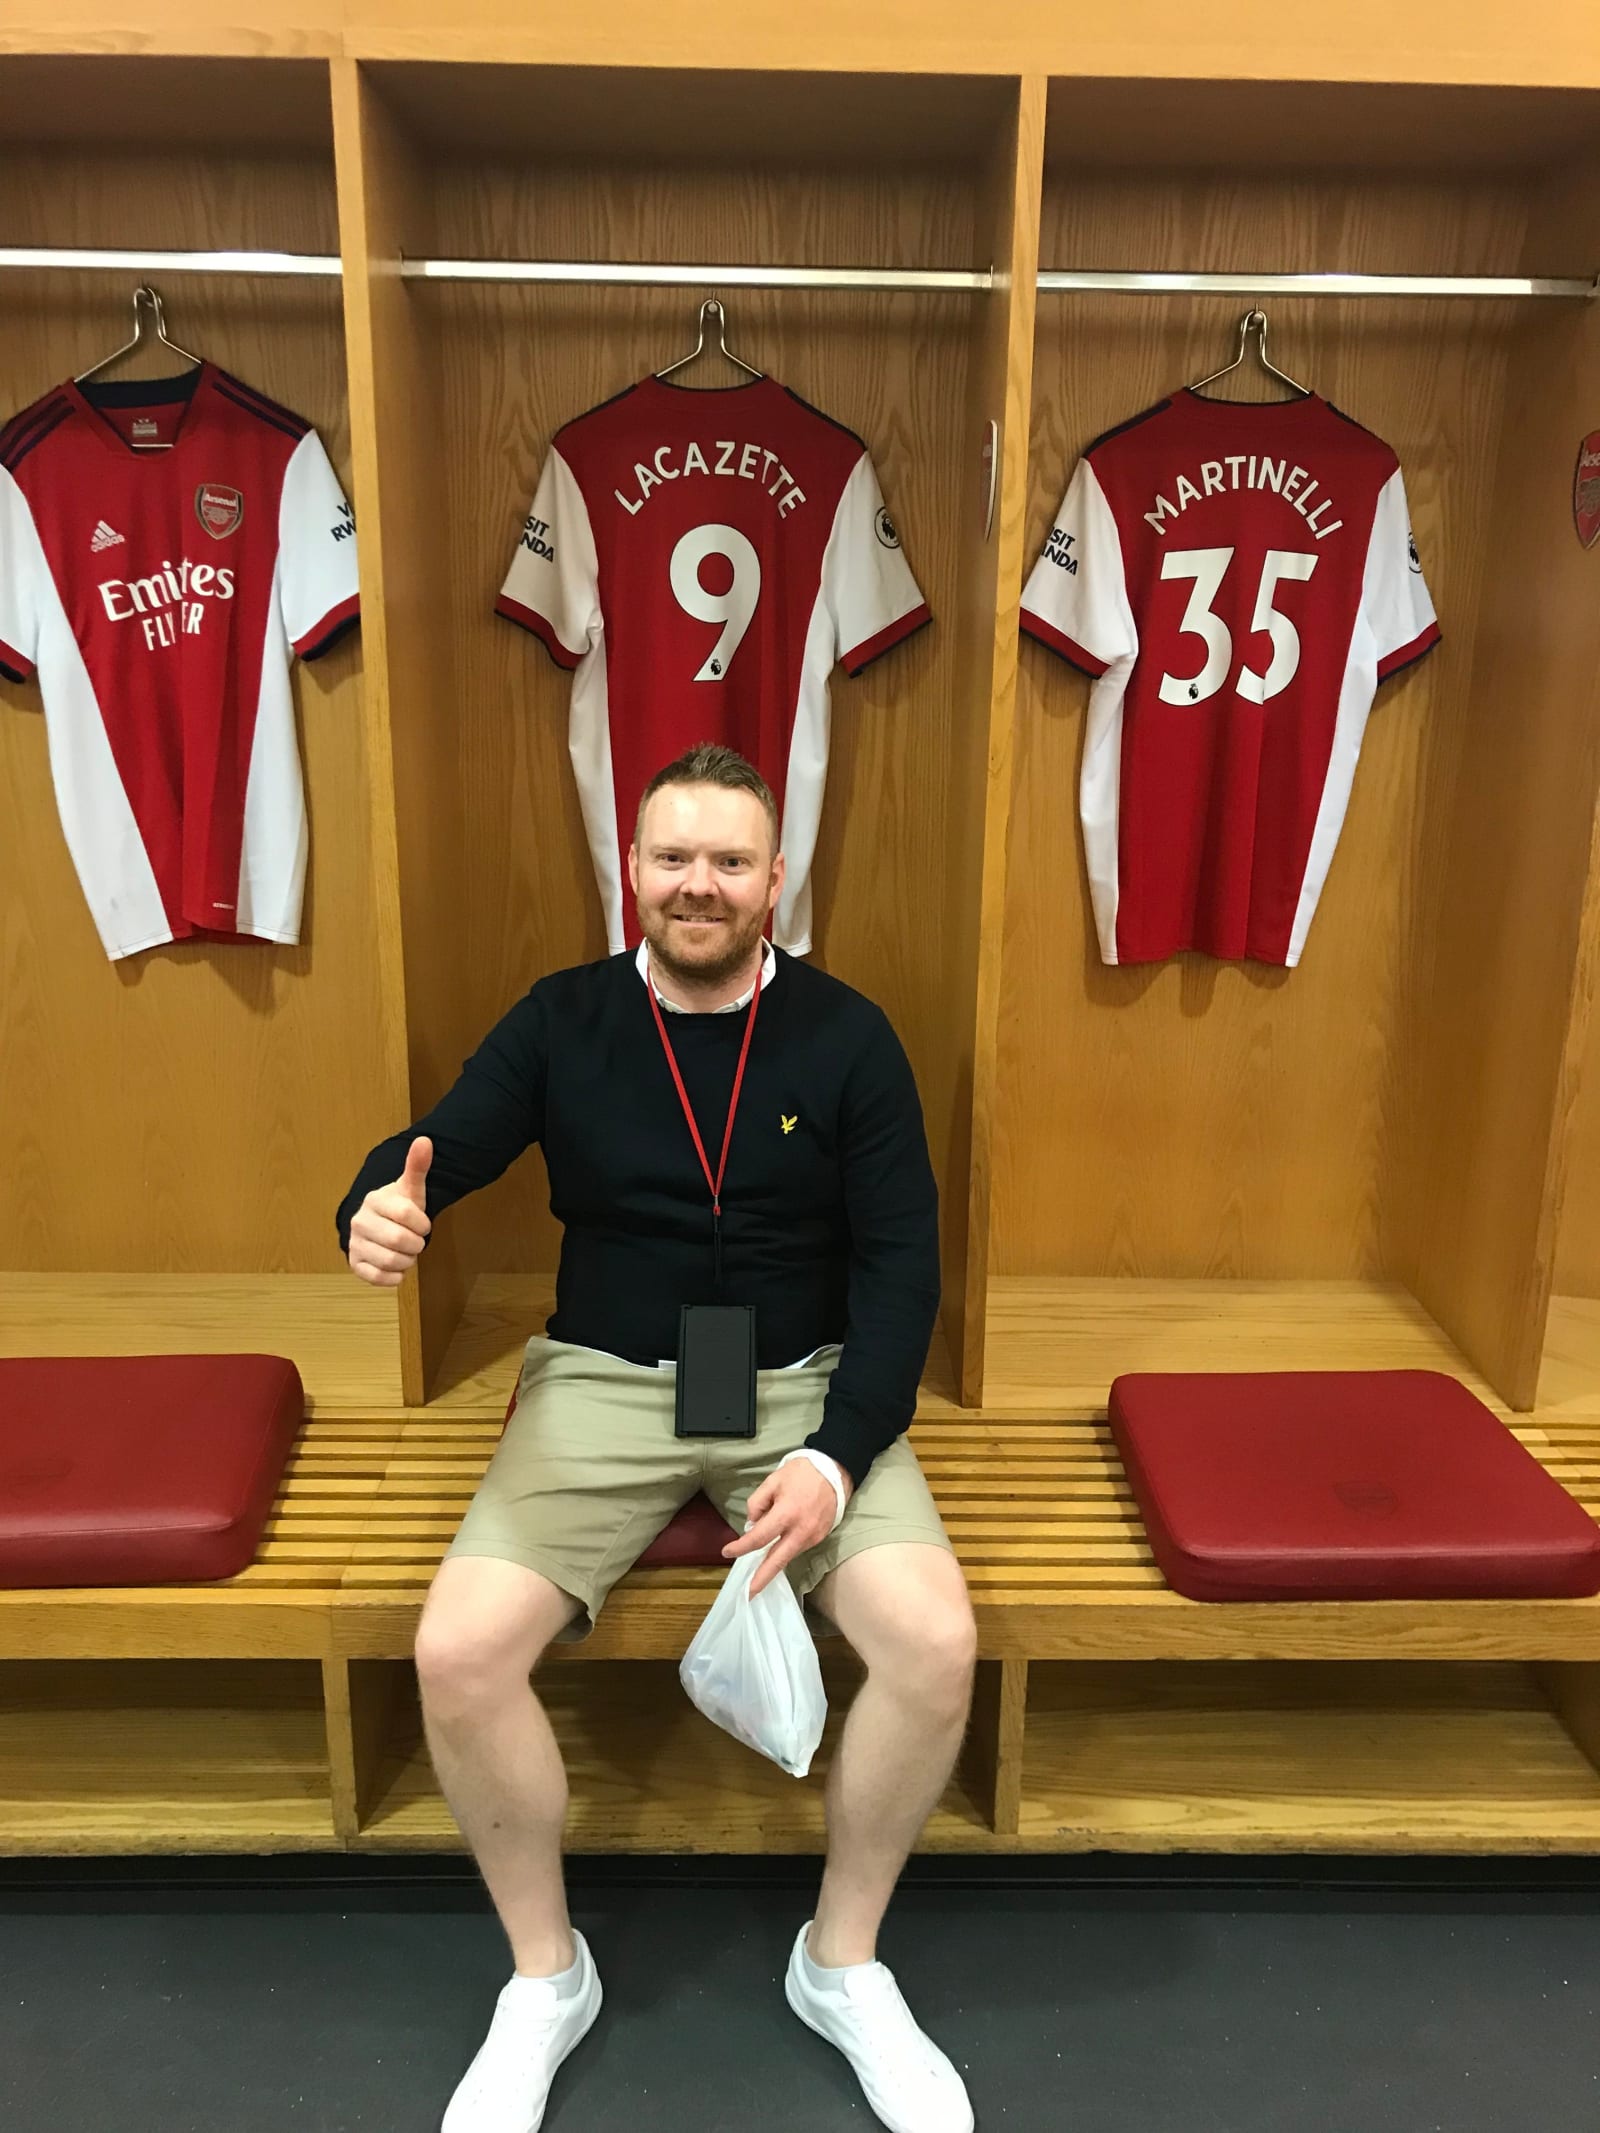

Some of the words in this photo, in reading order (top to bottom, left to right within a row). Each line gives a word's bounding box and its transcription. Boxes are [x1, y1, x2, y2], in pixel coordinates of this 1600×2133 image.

[613, 441, 807, 519] LACAZETTE
[1143, 455, 1343, 540] MARTINELLI
[669, 523, 761, 682] 9
[1040, 545, 1078, 576] NDA
[1158, 547, 1319, 706] 35
